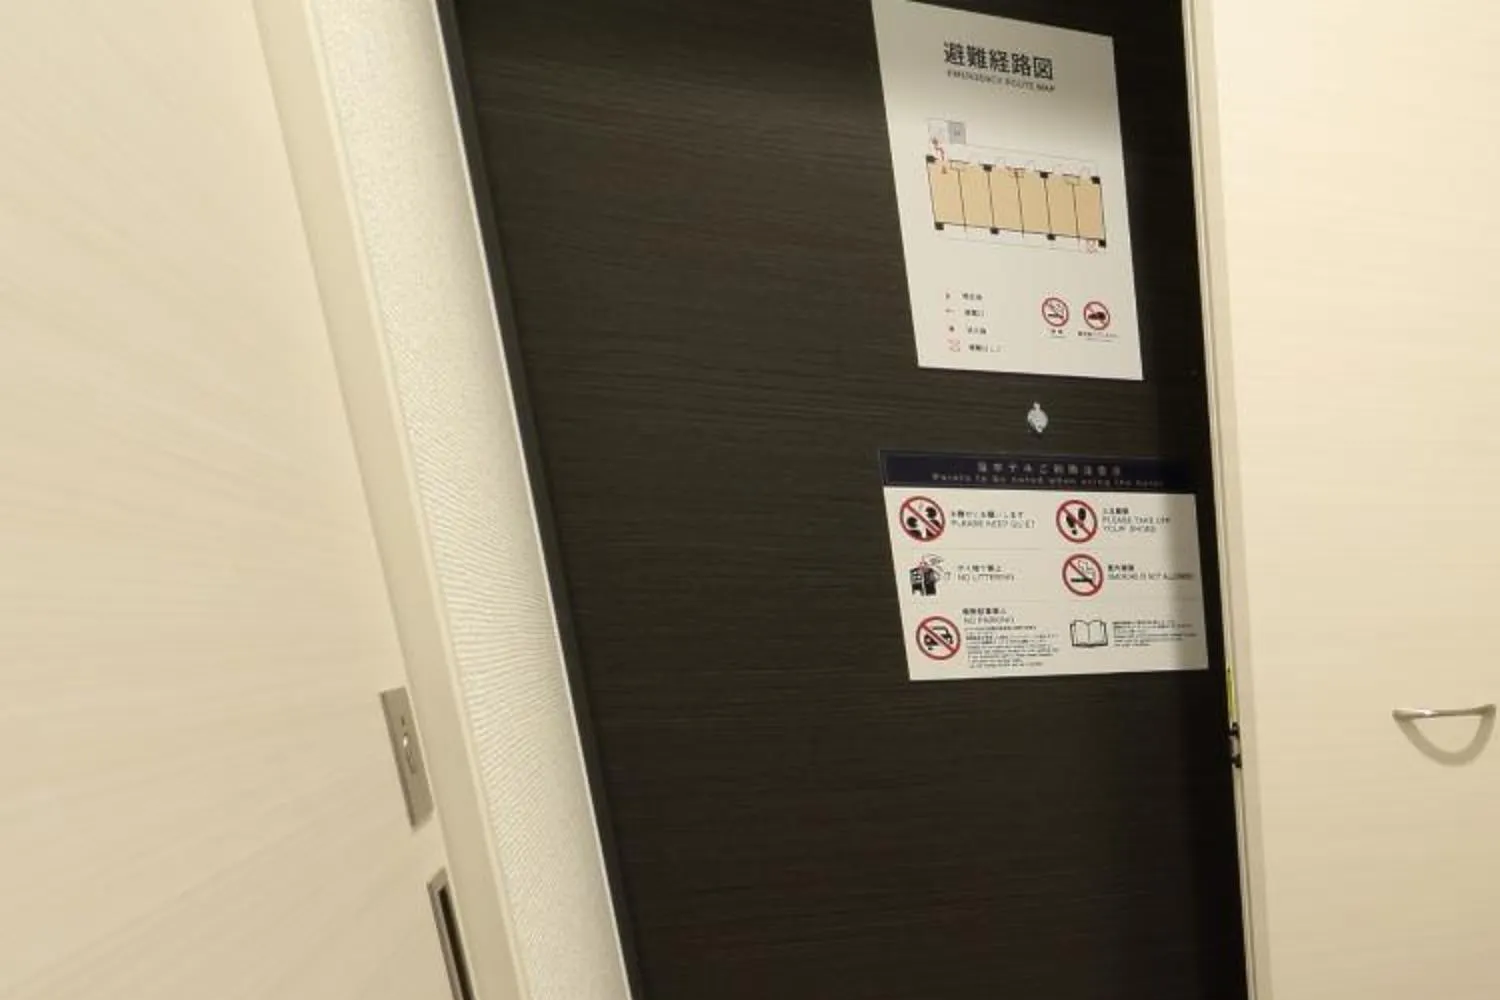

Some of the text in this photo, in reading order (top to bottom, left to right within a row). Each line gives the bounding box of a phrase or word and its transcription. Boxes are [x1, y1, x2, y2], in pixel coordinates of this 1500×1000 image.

[943, 42, 1053, 80] 避難経路図
[947, 69, 1002, 84] EMERGENCY
[1005, 77, 1034, 90] ROUTE
